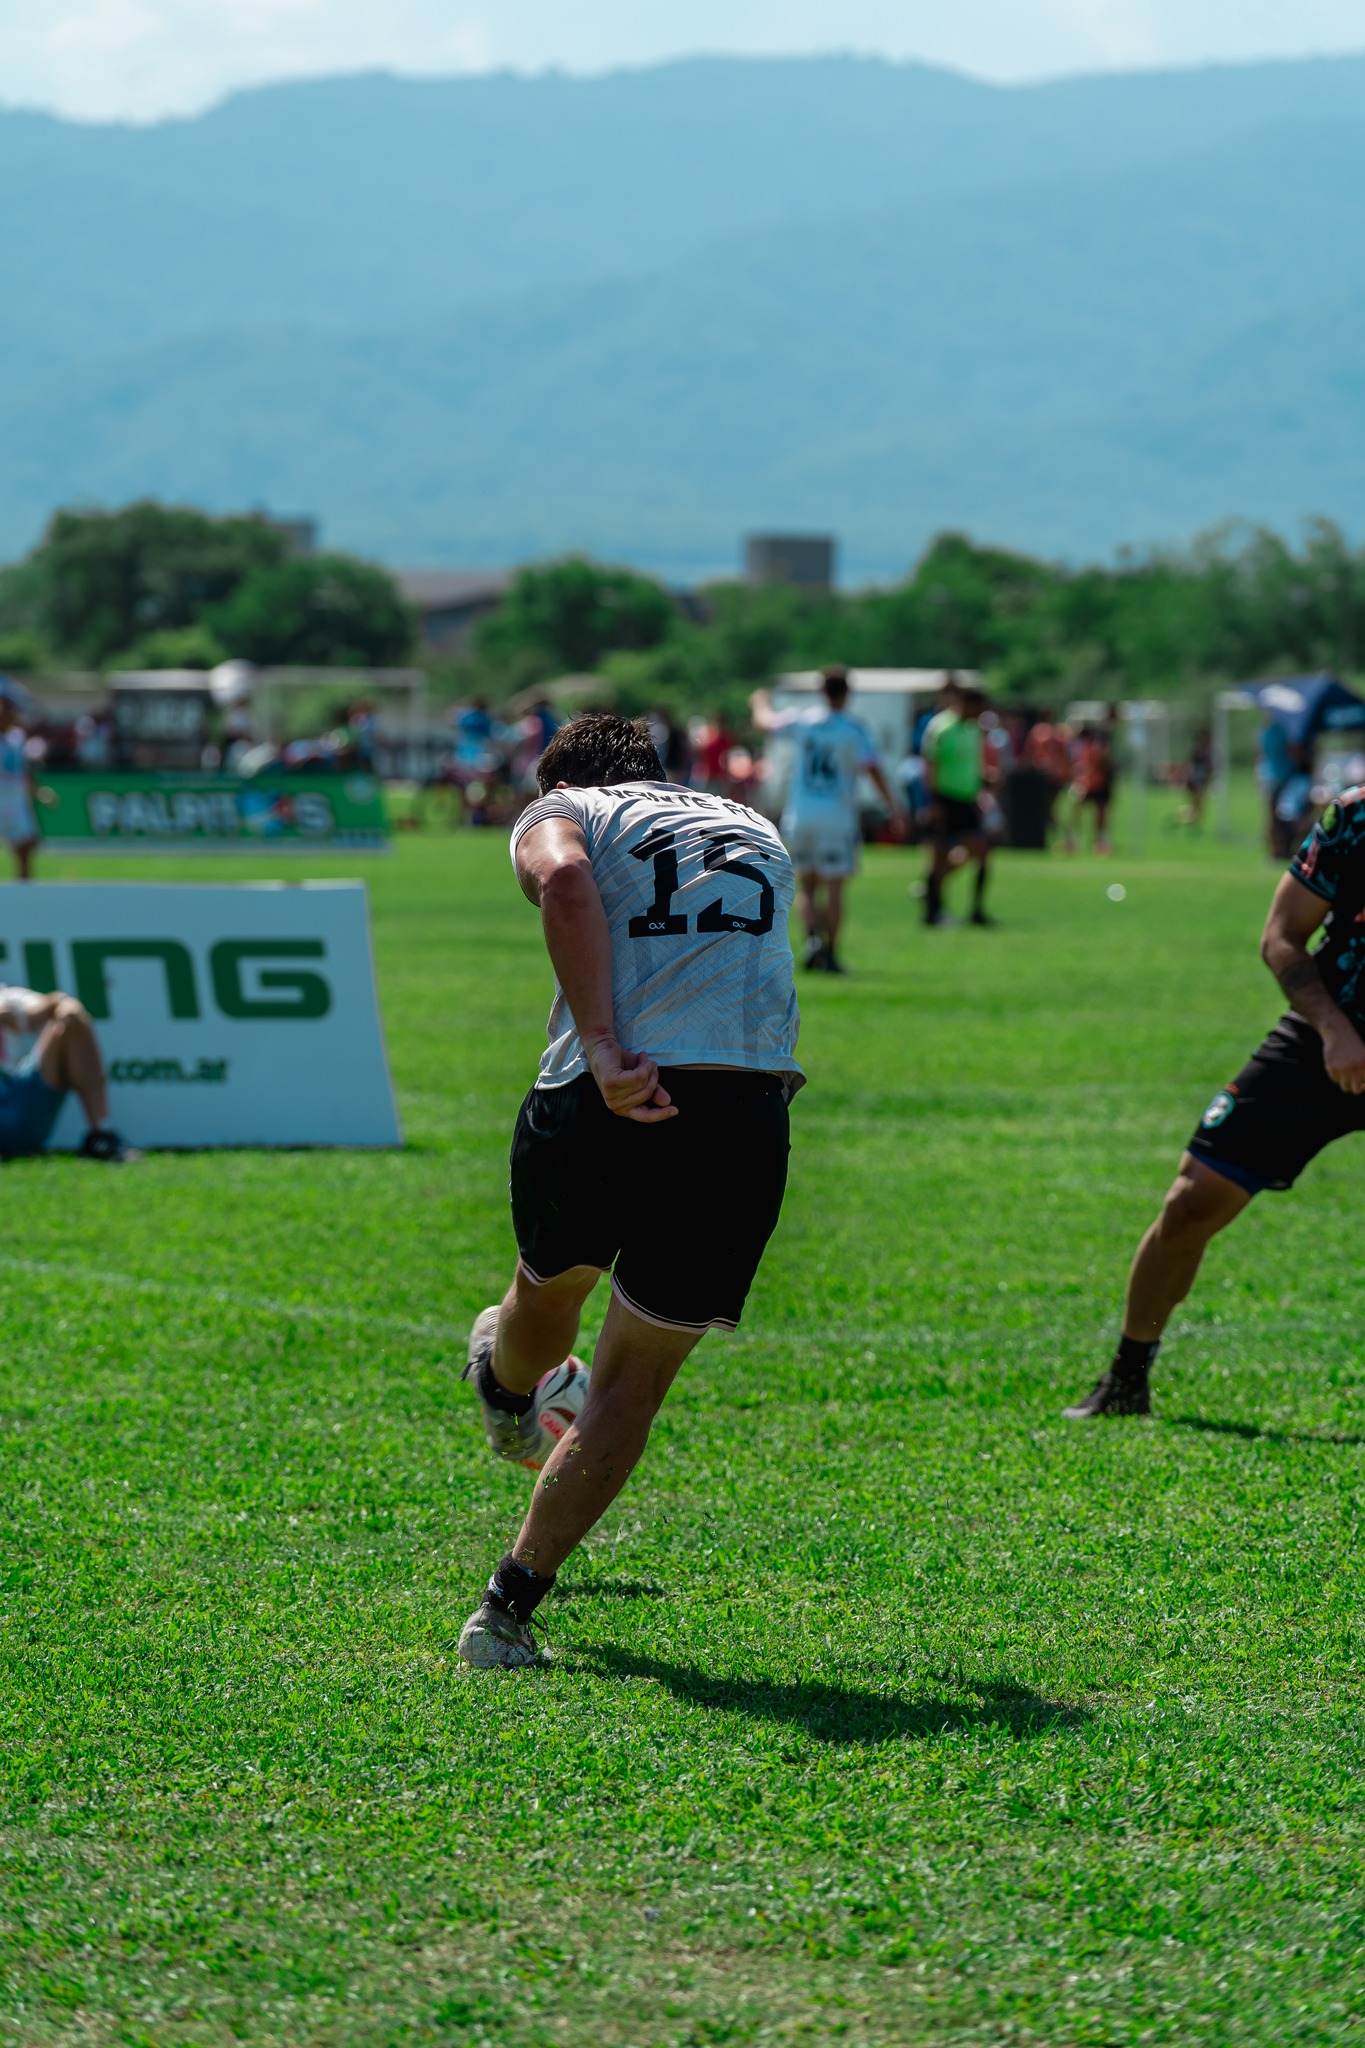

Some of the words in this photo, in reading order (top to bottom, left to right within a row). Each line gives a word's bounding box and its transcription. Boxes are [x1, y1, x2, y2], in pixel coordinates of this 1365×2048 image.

[88, 792, 334, 837] PALPITS
[627, 828, 775, 938] 15
[0, 938, 333, 1021] ING
[106, 1058, 228, 1084] com.ar
